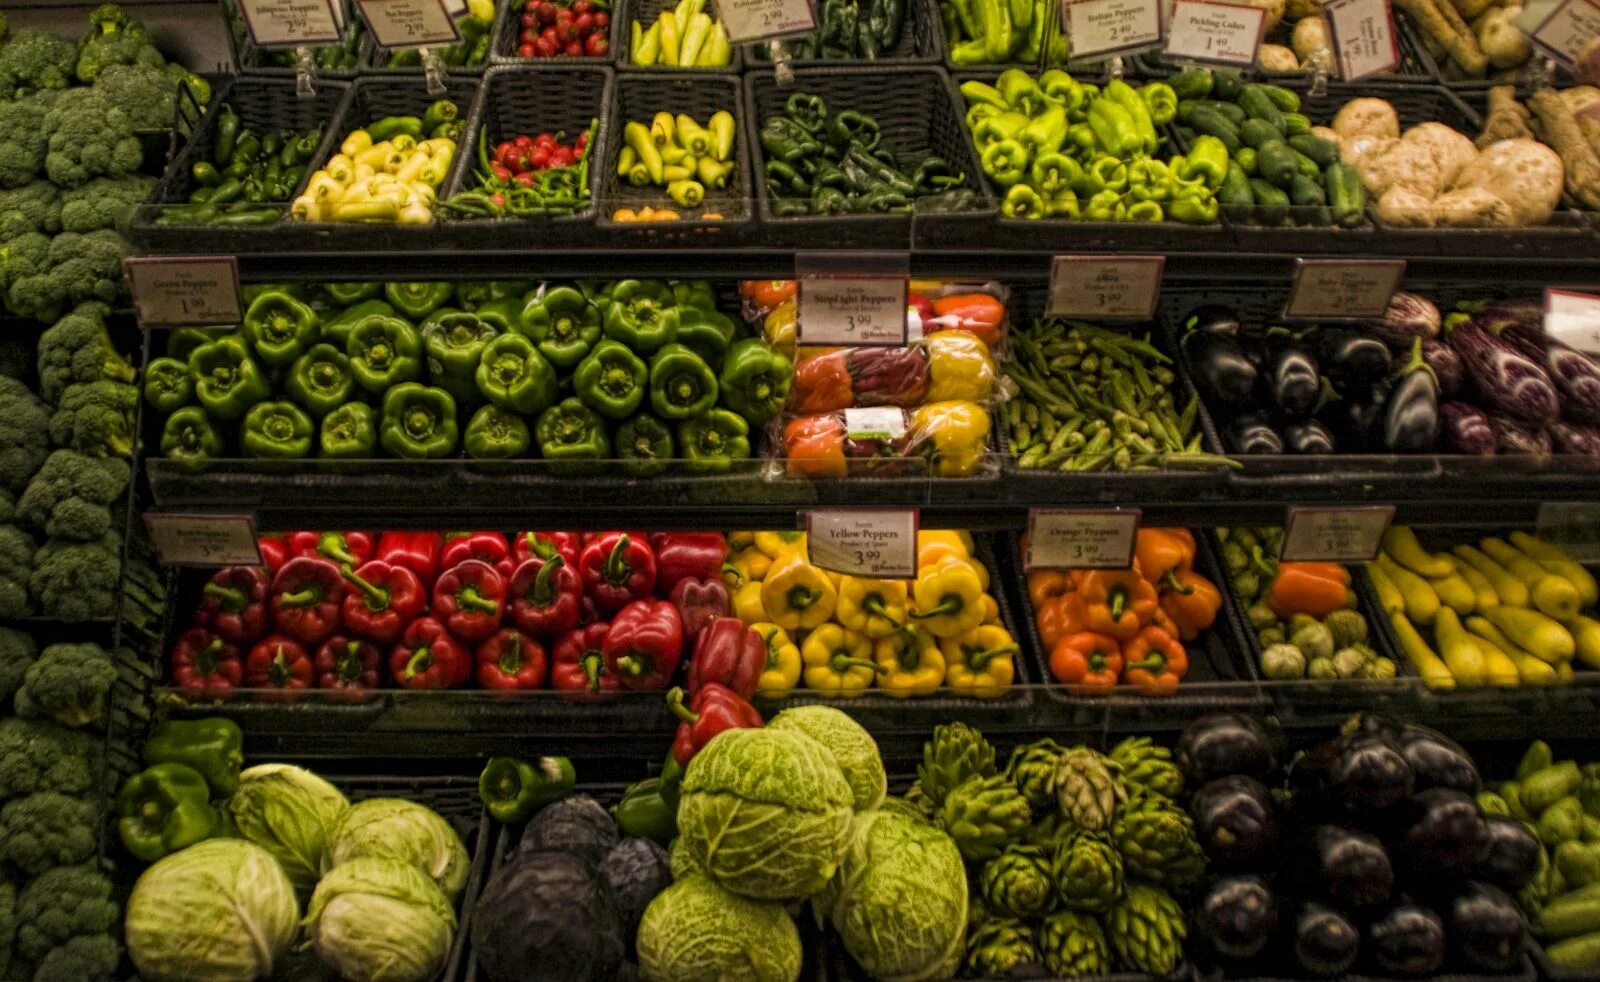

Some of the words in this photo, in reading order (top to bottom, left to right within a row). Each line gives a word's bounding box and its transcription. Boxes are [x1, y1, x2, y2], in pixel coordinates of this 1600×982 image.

[1088, 11, 1113, 23] Italian
[1114, 6, 1145, 18] Peppers
[1189, 16, 1220, 28] Pickling
[182, 280, 217, 290] Peppers
[861, 294, 897, 305] Peppers
[829, 529, 860, 539] Yellow
[862, 529, 899, 541] Peppers
[1050, 528, 1081, 538] Orange
[1084, 528, 1119, 537] Peppers
